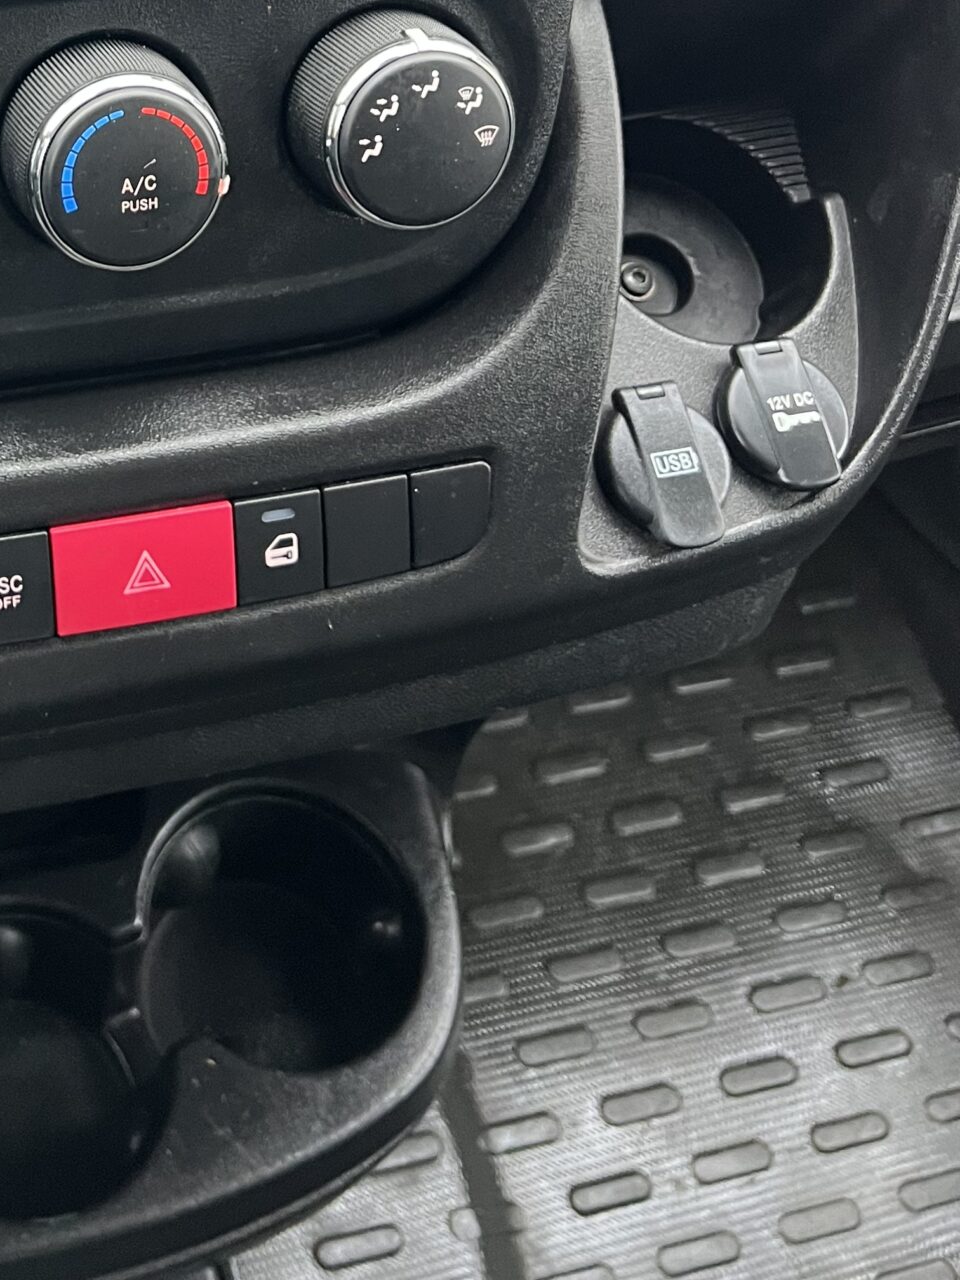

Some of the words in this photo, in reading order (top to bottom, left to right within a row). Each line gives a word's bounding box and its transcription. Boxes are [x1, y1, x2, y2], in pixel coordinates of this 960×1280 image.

[121, 175, 157, 196] A/C
[121, 197, 158, 214] PUSH
[766, 392, 791, 411] 12V
[793, 390, 815, 408] DC
[655, 453, 692, 473] USB
